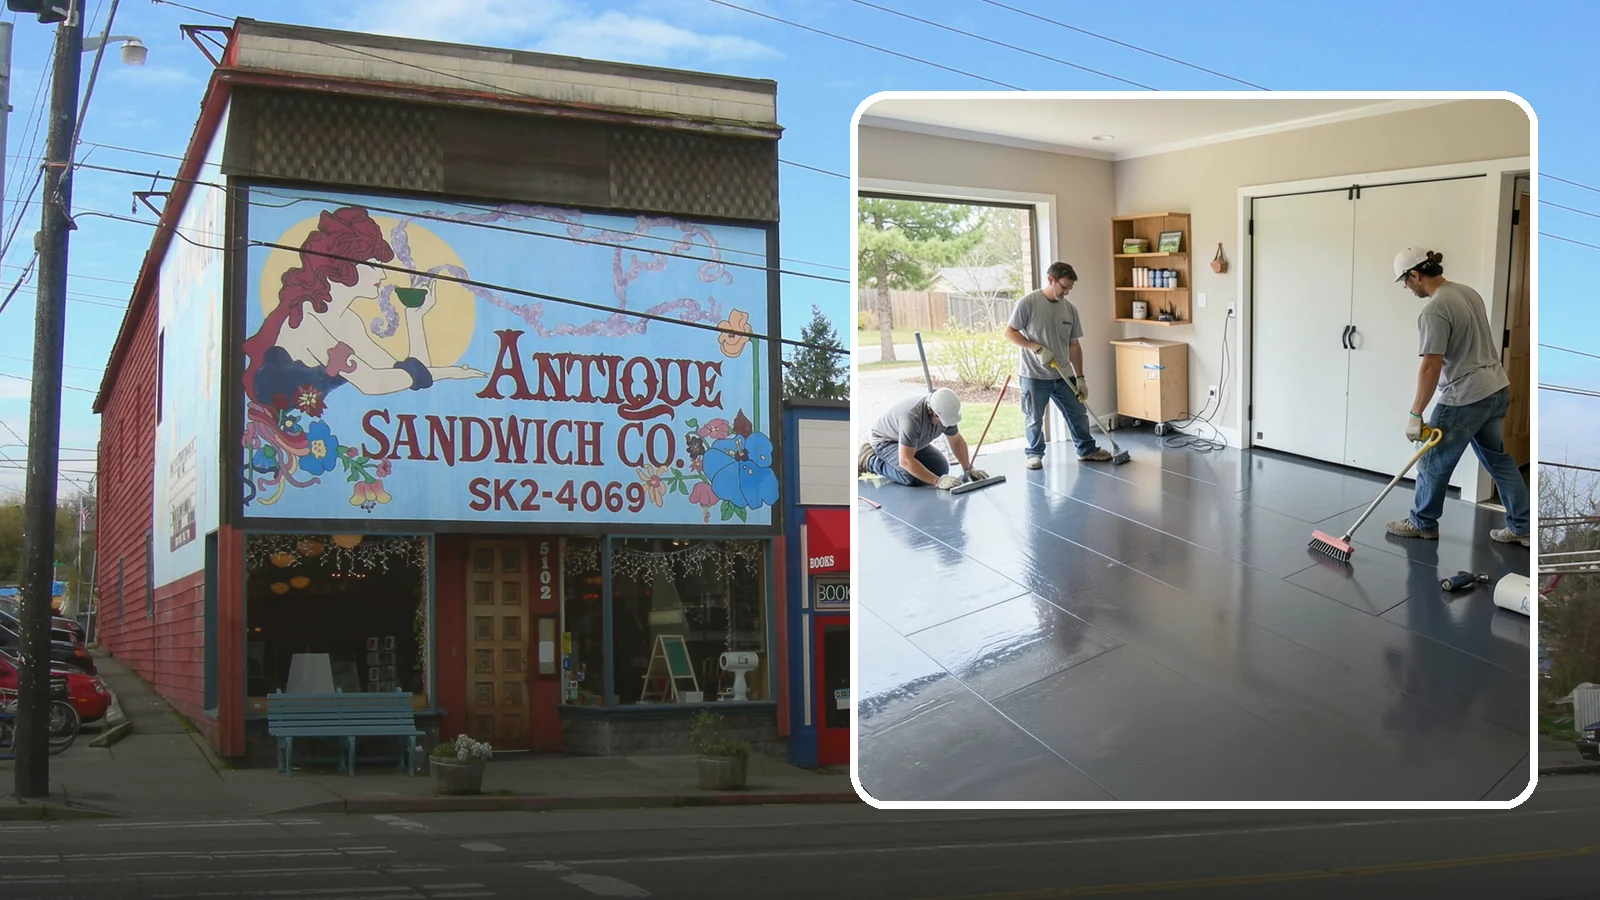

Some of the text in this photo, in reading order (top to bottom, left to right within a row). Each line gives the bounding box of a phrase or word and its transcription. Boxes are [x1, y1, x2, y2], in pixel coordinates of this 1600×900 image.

[476, 329, 724, 421] ANTIQUE
[361, 409, 685, 469] SANDWICH CO.
[469, 477, 646, 514] SK2-4069
[540, 541, 552, 600] 5102
[809, 555, 835, 569] BOOKS
